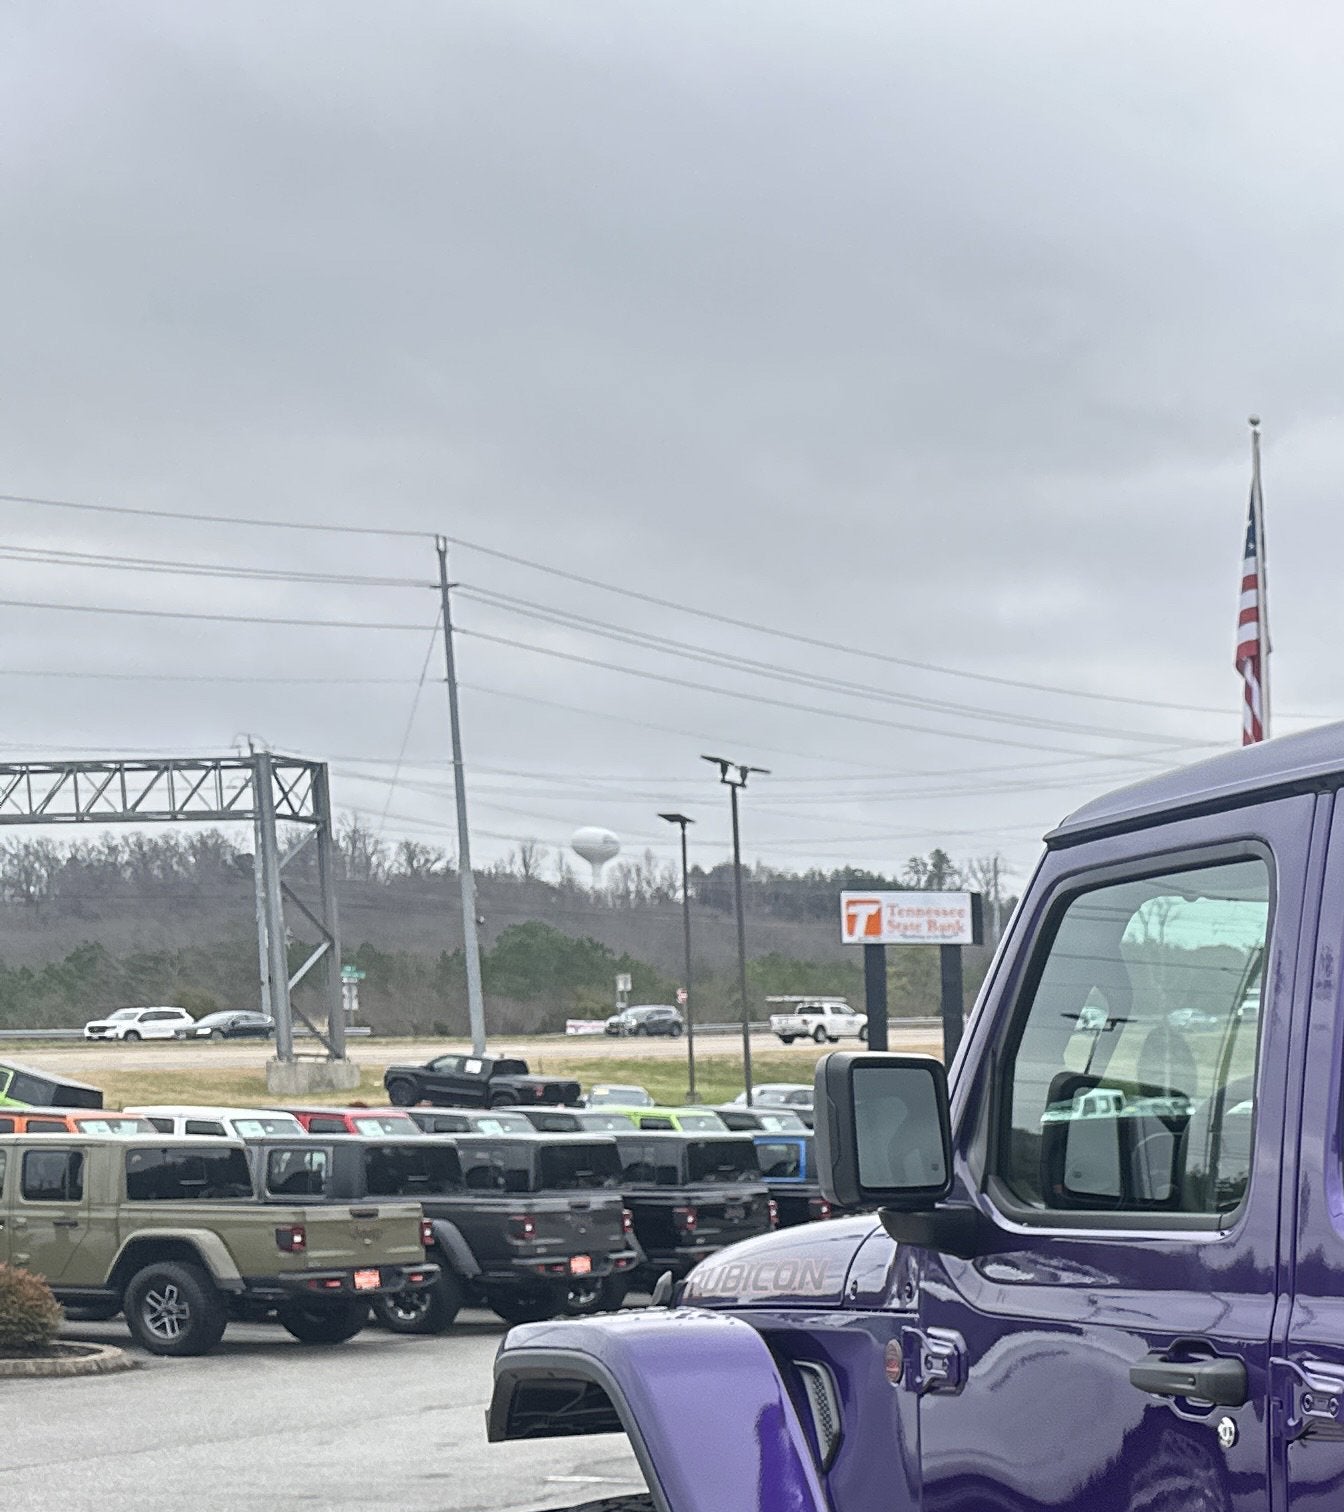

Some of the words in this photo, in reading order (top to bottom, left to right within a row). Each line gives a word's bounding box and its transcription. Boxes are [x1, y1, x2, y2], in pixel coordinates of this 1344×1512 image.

[886, 903, 966, 919] Tennessee
[887, 920, 922, 934] State
[927, 919, 966, 934] Bank
